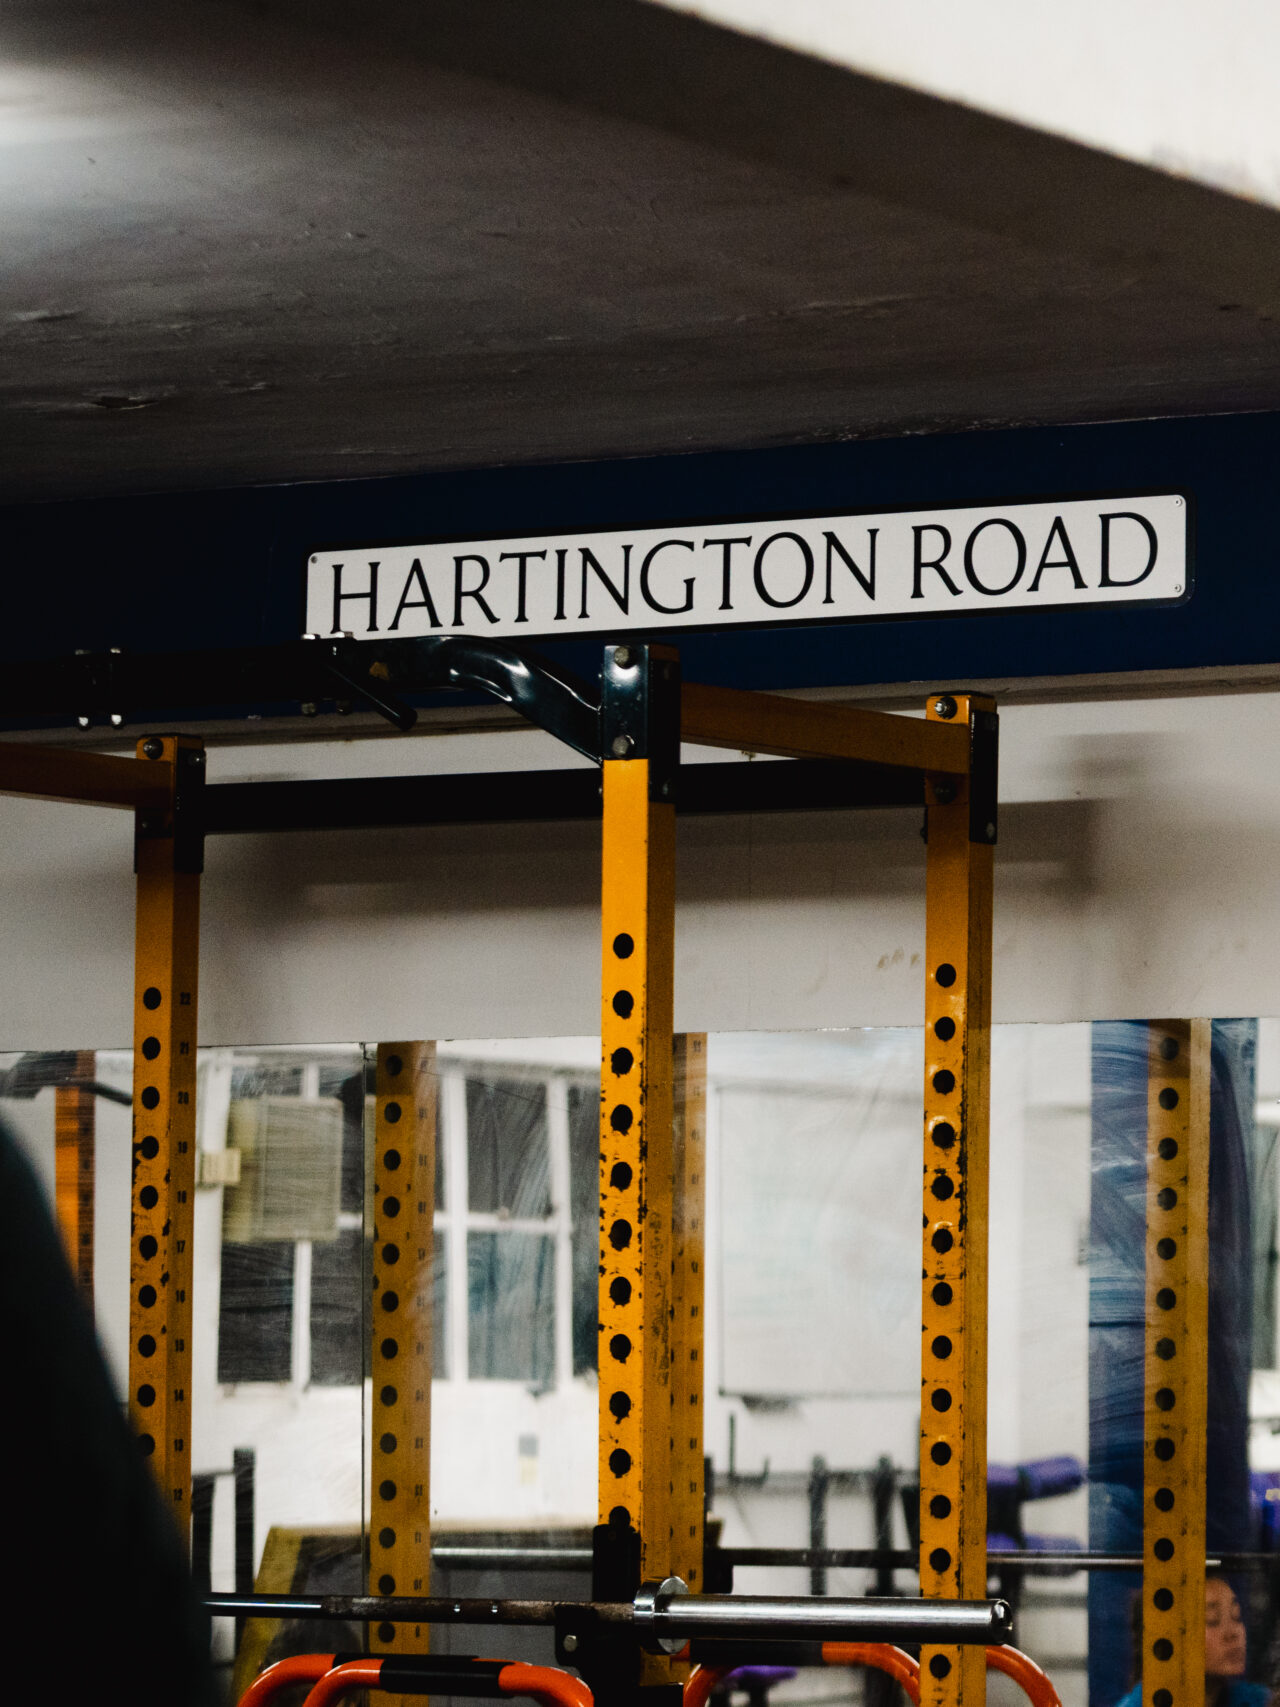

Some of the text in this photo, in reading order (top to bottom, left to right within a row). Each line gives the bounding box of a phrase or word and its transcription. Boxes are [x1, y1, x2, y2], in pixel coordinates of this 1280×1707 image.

[330, 511, 1159, 634] HARTINGTON ROAD
[180, 992, 191, 1005] 22
[179, 1042, 189, 1054] 21
[178, 1091, 189, 1104] 20
[177, 1240, 186, 1252] 17
[174, 1438, 183, 1451] 13
[174, 1488, 183, 1501] 12
